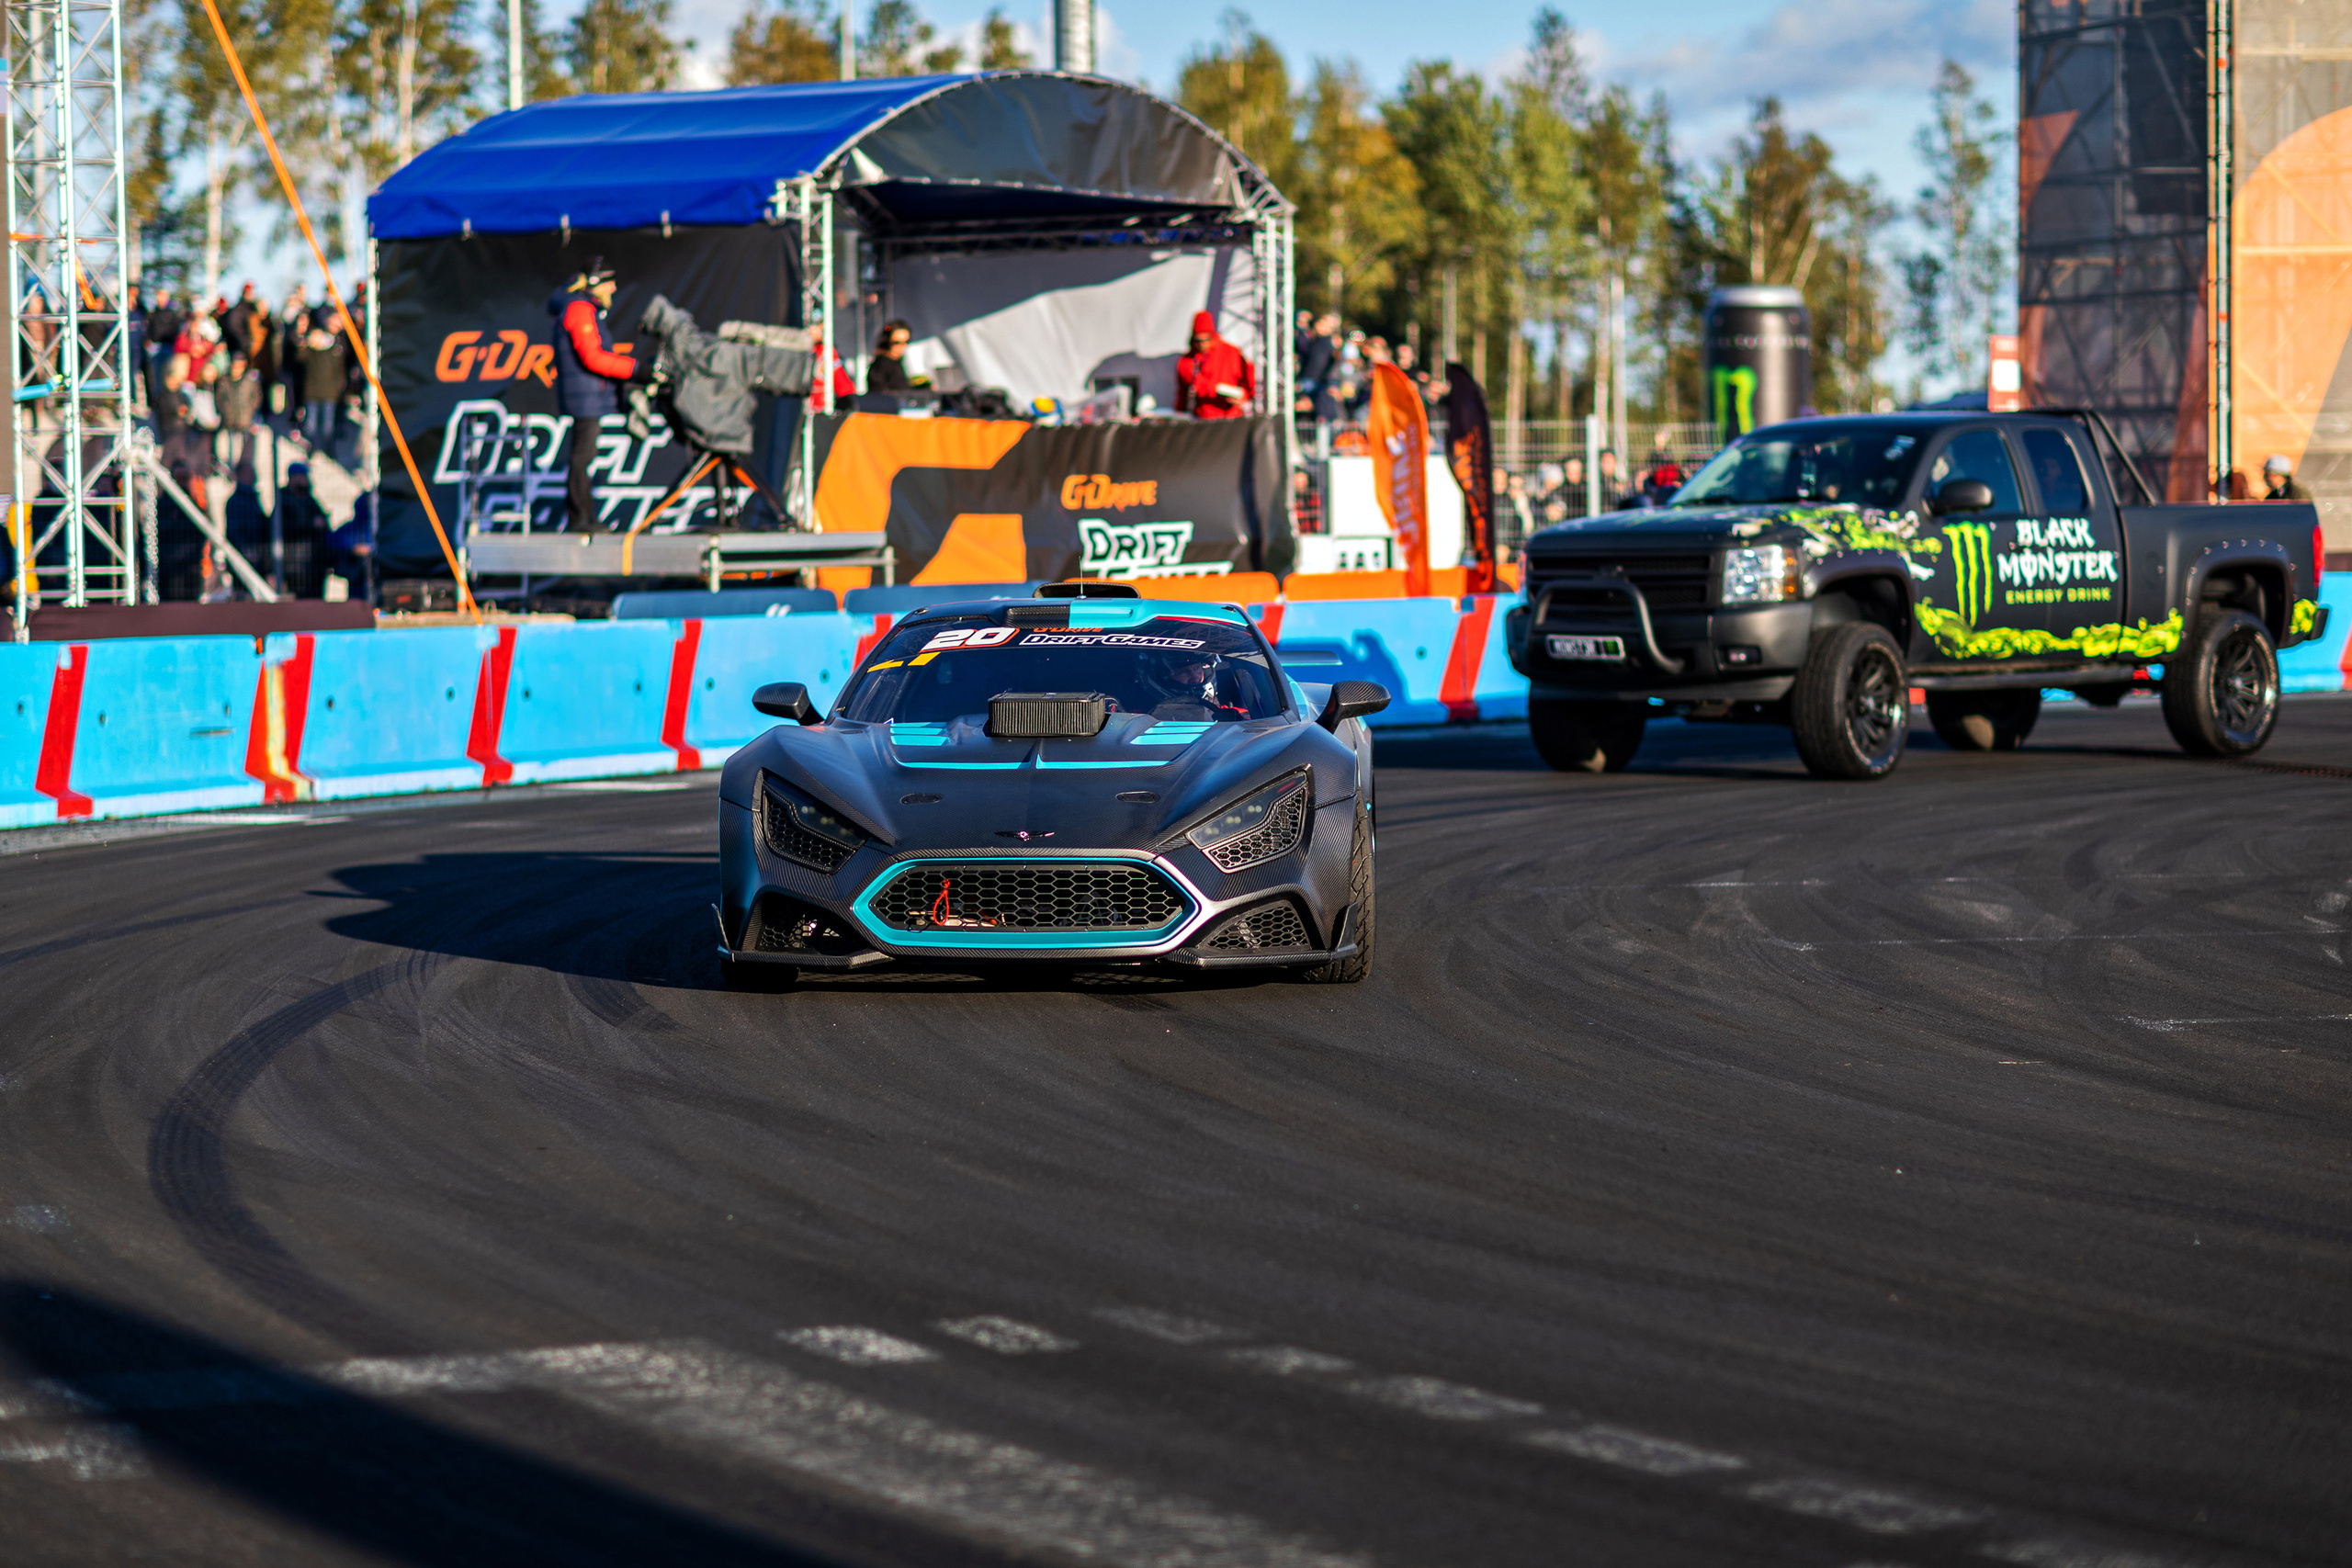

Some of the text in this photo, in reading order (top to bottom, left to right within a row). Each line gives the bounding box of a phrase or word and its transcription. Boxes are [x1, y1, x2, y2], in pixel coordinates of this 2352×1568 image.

[1079, 519, 1193, 570] DRIFT
[2016, 517, 2096, 548] BLACK
[2006, 587, 2112, 604] ENERGY DRINK
[920, 626, 1020, 652] 20
[1019, 634, 1205, 649] DRIFT GAMES
